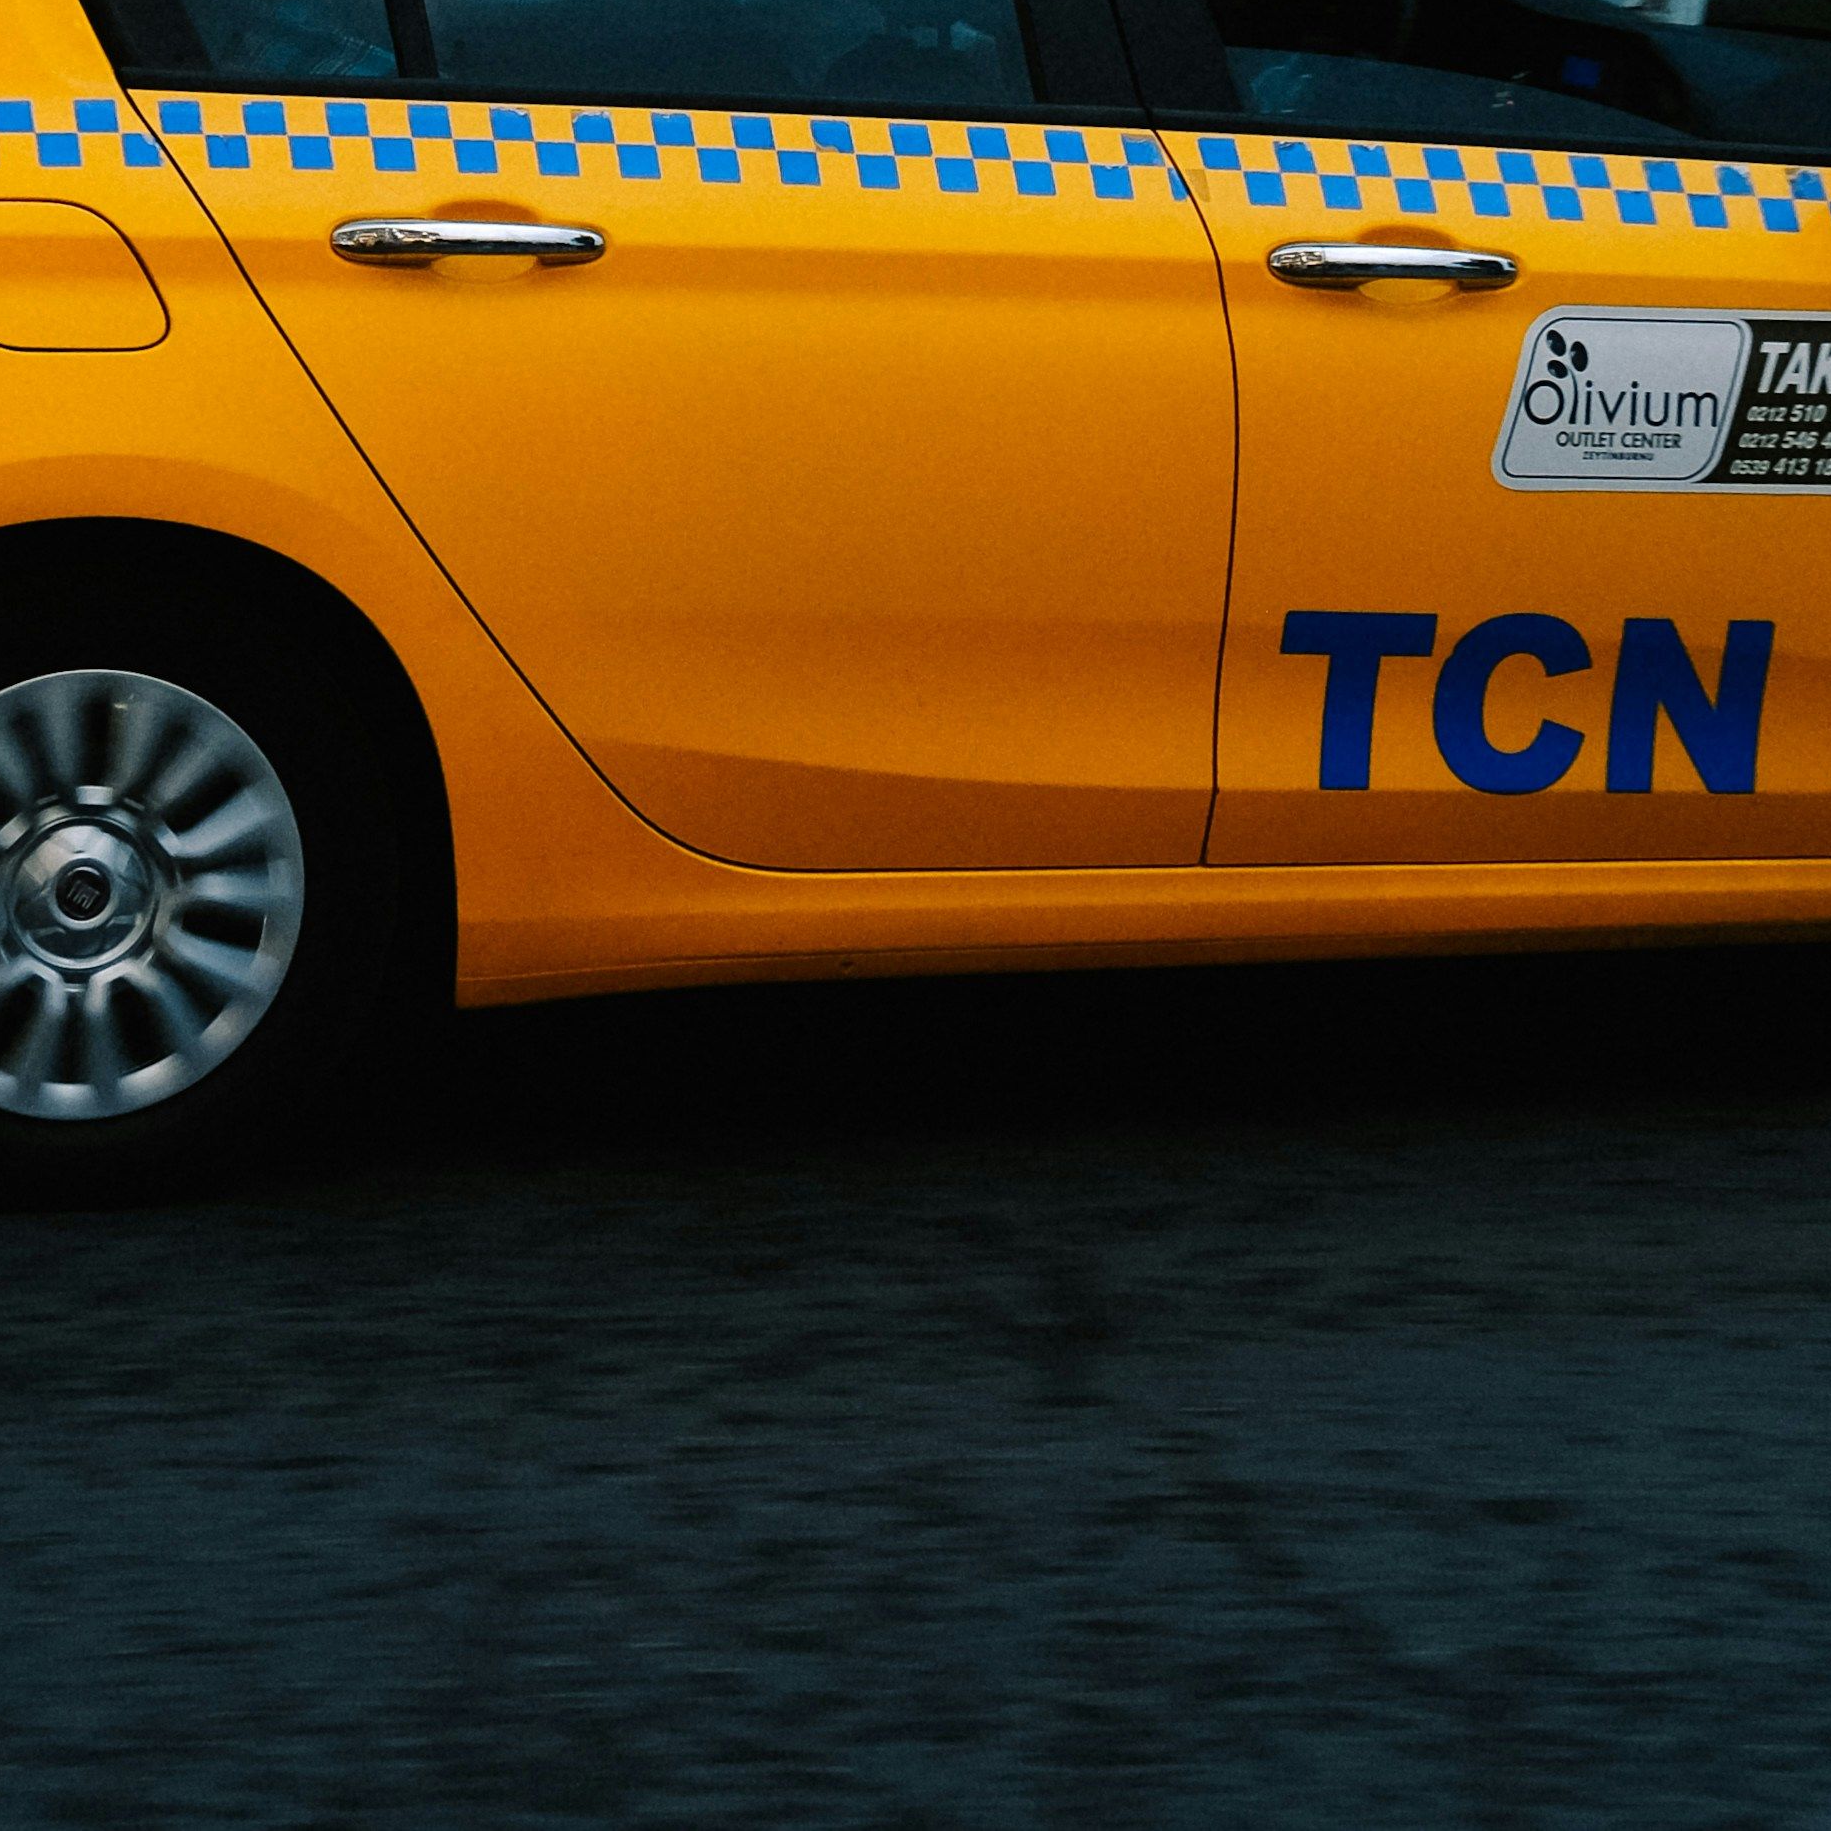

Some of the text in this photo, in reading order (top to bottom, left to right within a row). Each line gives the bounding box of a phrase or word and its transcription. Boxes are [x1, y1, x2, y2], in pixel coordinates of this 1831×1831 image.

[1524, 372, 1718, 428] Olivium
[1789, 404, 1828, 423] 510
[1556, 431, 1681, 448] OUTLET CENTER
[1773, 457, 1811, 475] 413
[1280, 610, 1775, 796] TCN
